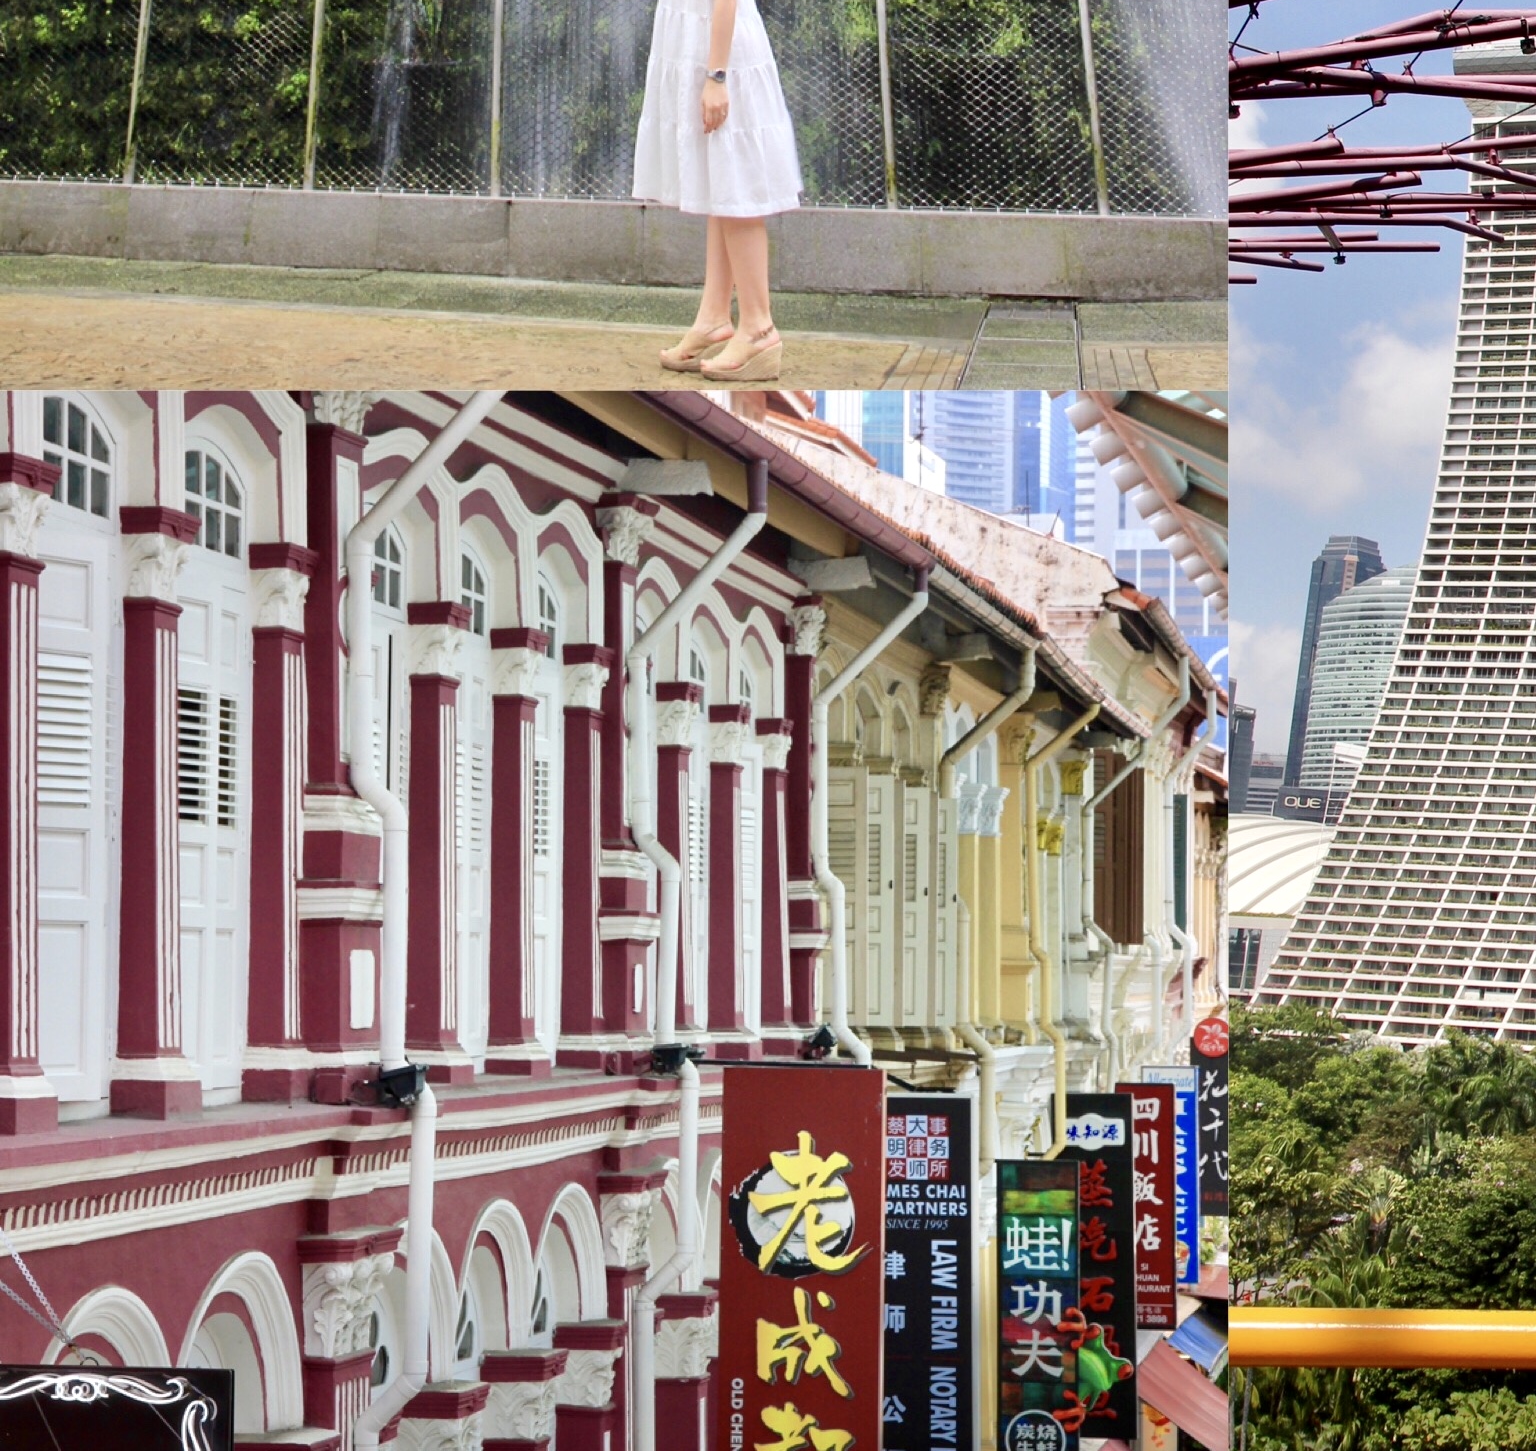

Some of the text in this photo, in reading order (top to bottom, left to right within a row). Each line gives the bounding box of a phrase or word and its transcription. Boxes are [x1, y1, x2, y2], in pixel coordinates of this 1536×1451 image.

[1284, 796, 1322, 809] OUE
[926, 1184, 966, 1199] CHAI
[885, 1201, 968, 1217] PARTNERS
[886, 1218, 949, 1230] SINCE 1995
[1141, 1263, 1149, 1271] SI
[931, 1239, 958, 1350] LAW FIRM
[730, 1377, 744, 1409] OLD
[929, 1366, 957, 1444] NOTARY
